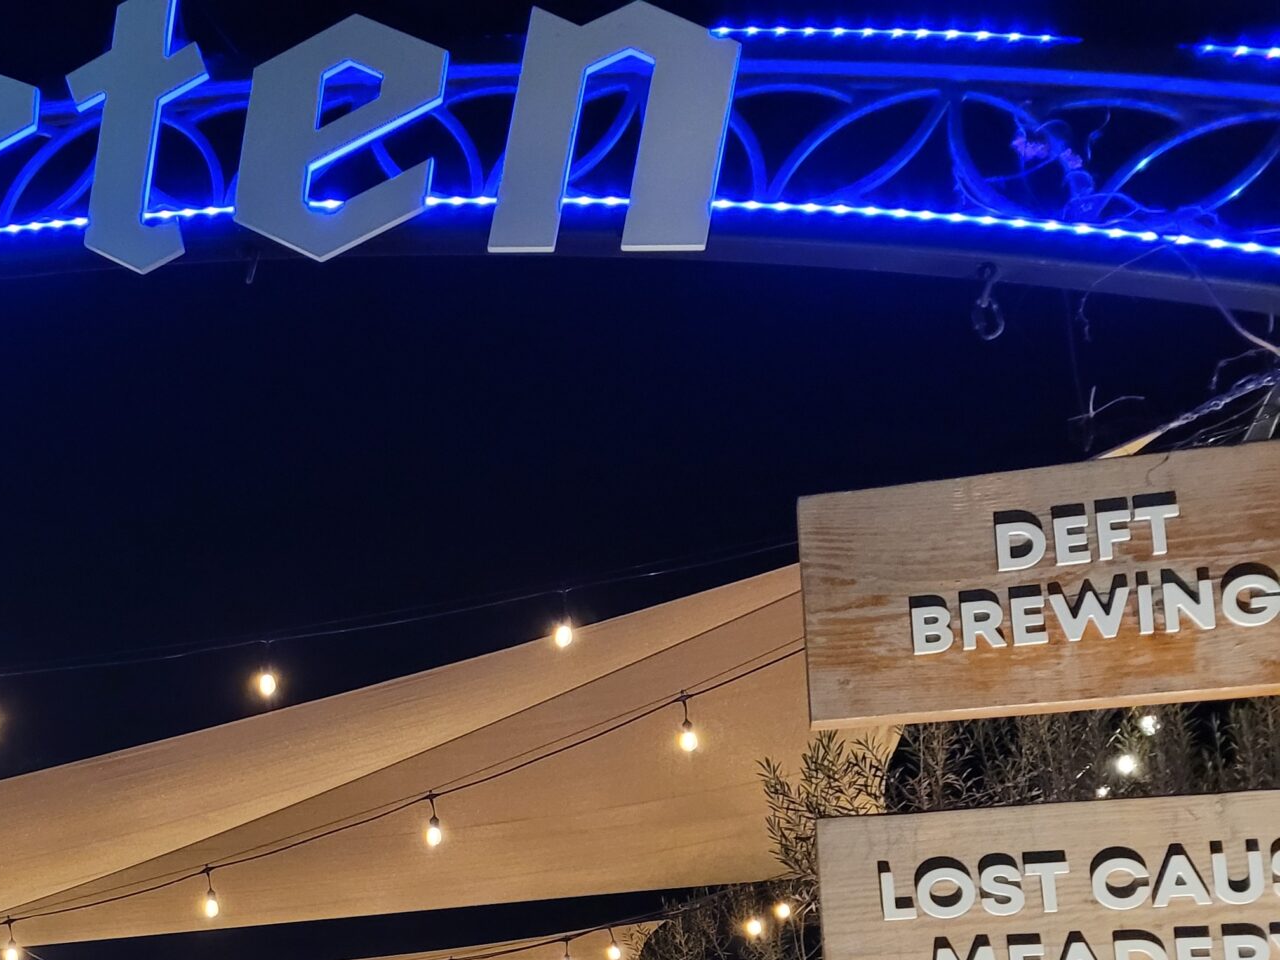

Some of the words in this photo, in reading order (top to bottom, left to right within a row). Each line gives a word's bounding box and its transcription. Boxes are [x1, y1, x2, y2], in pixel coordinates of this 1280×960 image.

[994, 498, 1180, 572] DEFT
[910, 568, 1280, 655] BREWING
[878, 856, 1070, 921] LOST
[1091, 845, 1280, 910] CAU
